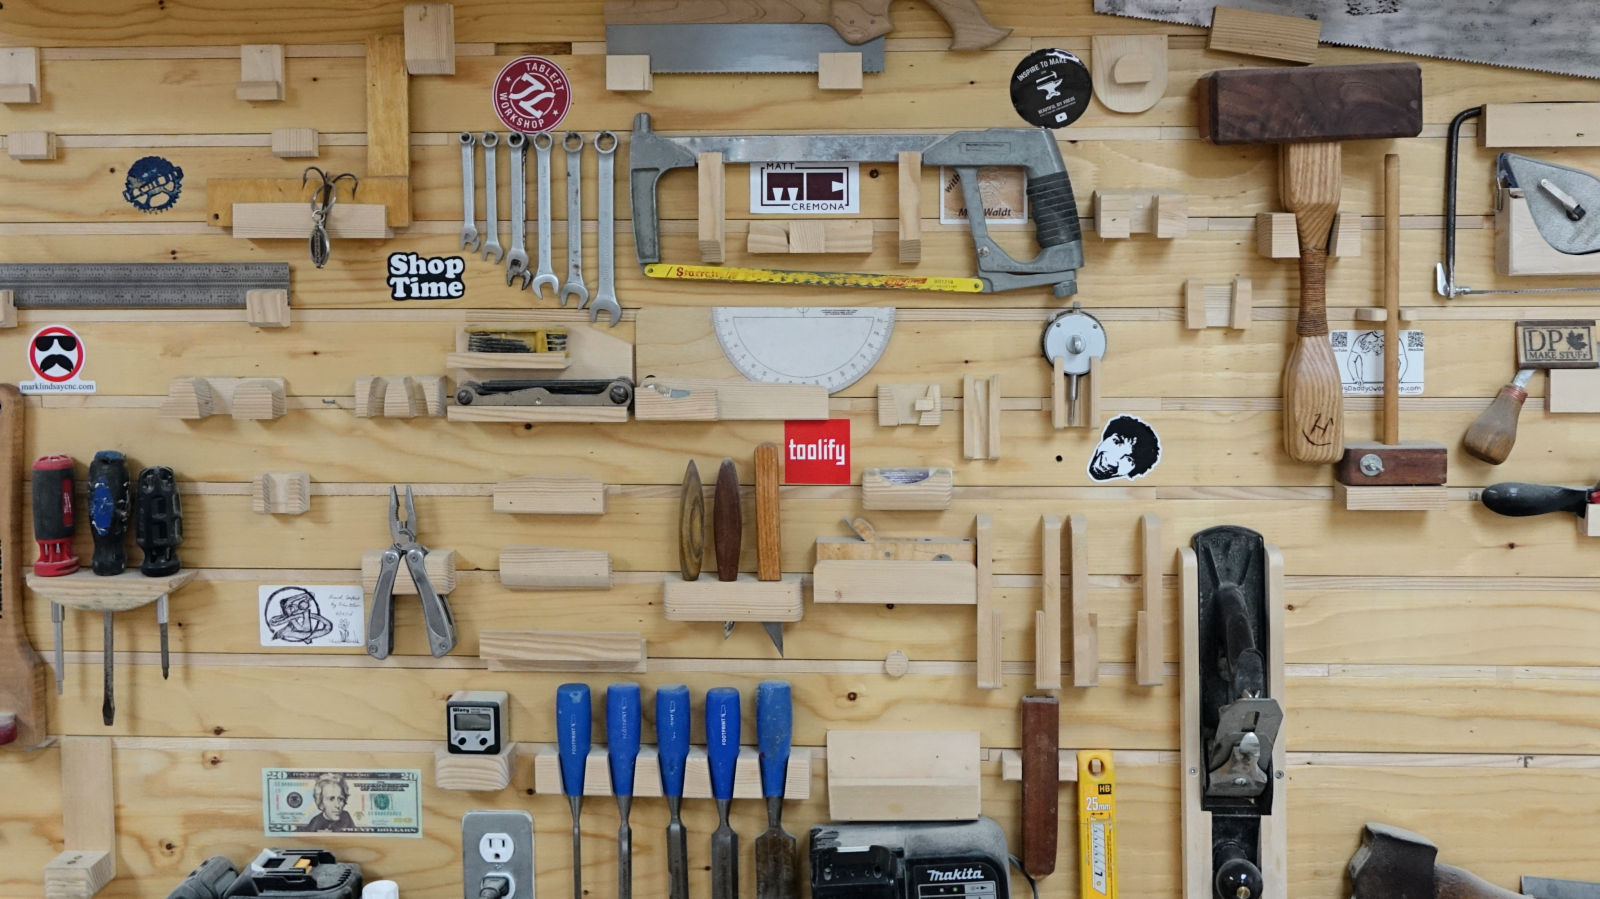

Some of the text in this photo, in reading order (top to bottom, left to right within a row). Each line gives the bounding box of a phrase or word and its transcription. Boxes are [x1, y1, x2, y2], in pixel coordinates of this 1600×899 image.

[526, 62, 565, 91] TABLEFT
[1017, 64, 1040, 82] INSPIRE
[1049, 57, 1068, 66] MAKE
[499, 92, 545, 129] WORKSHOP
[766, 162, 795, 170] MATT
[984, 207, 1011, 217] Waldt
[390, 254, 464, 279] Shop
[389, 276, 464, 298] Time
[1527, 329, 1563, 352] DP
[1559, 351, 1588, 359] STUFF
[21, 383, 94, 391] marklindsaycnc.com
[788, 438, 846, 466] toolify
[1099, 785, 1111, 793] HB
[1086, 797, 1111, 811] 25mm
